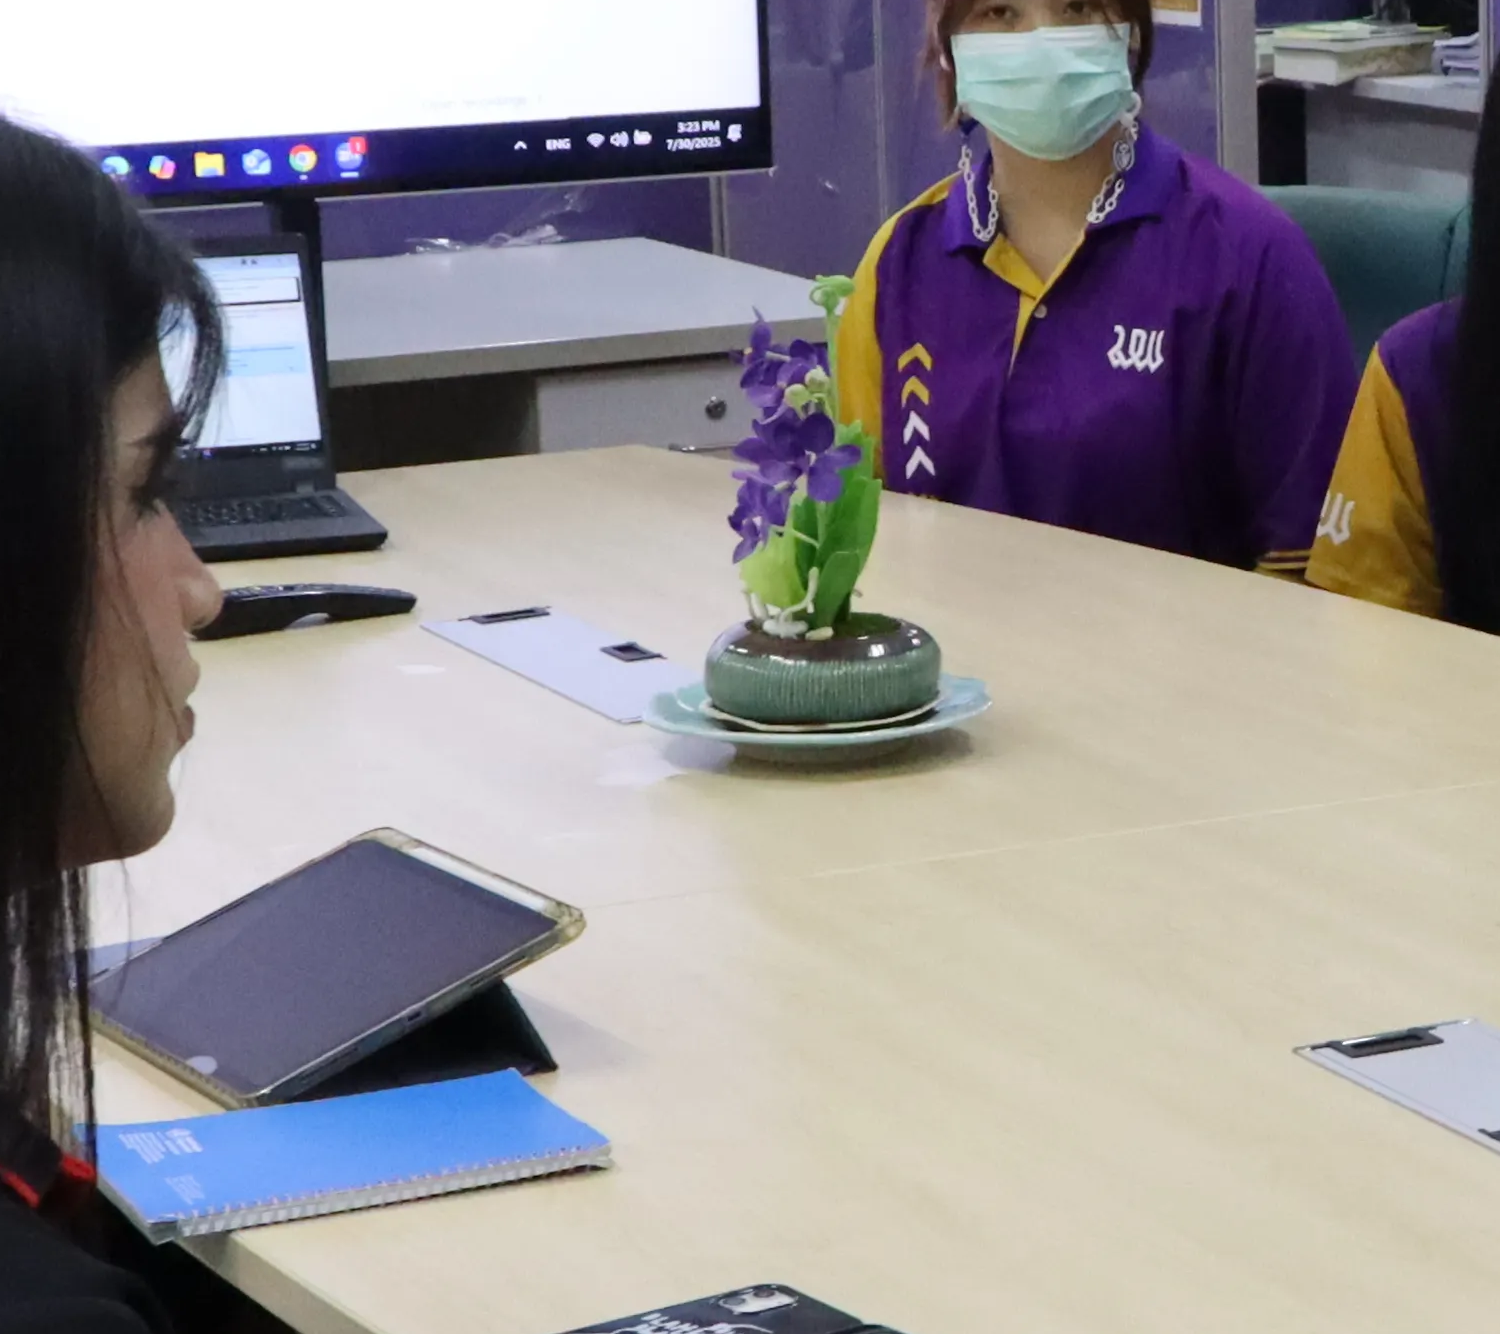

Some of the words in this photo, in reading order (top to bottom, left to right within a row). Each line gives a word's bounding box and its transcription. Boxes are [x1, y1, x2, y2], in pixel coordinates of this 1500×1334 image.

[701, 119, 721, 133] PM
[545, 138, 572, 151] ENG
[666, 136, 722, 151] 7/30/2025
